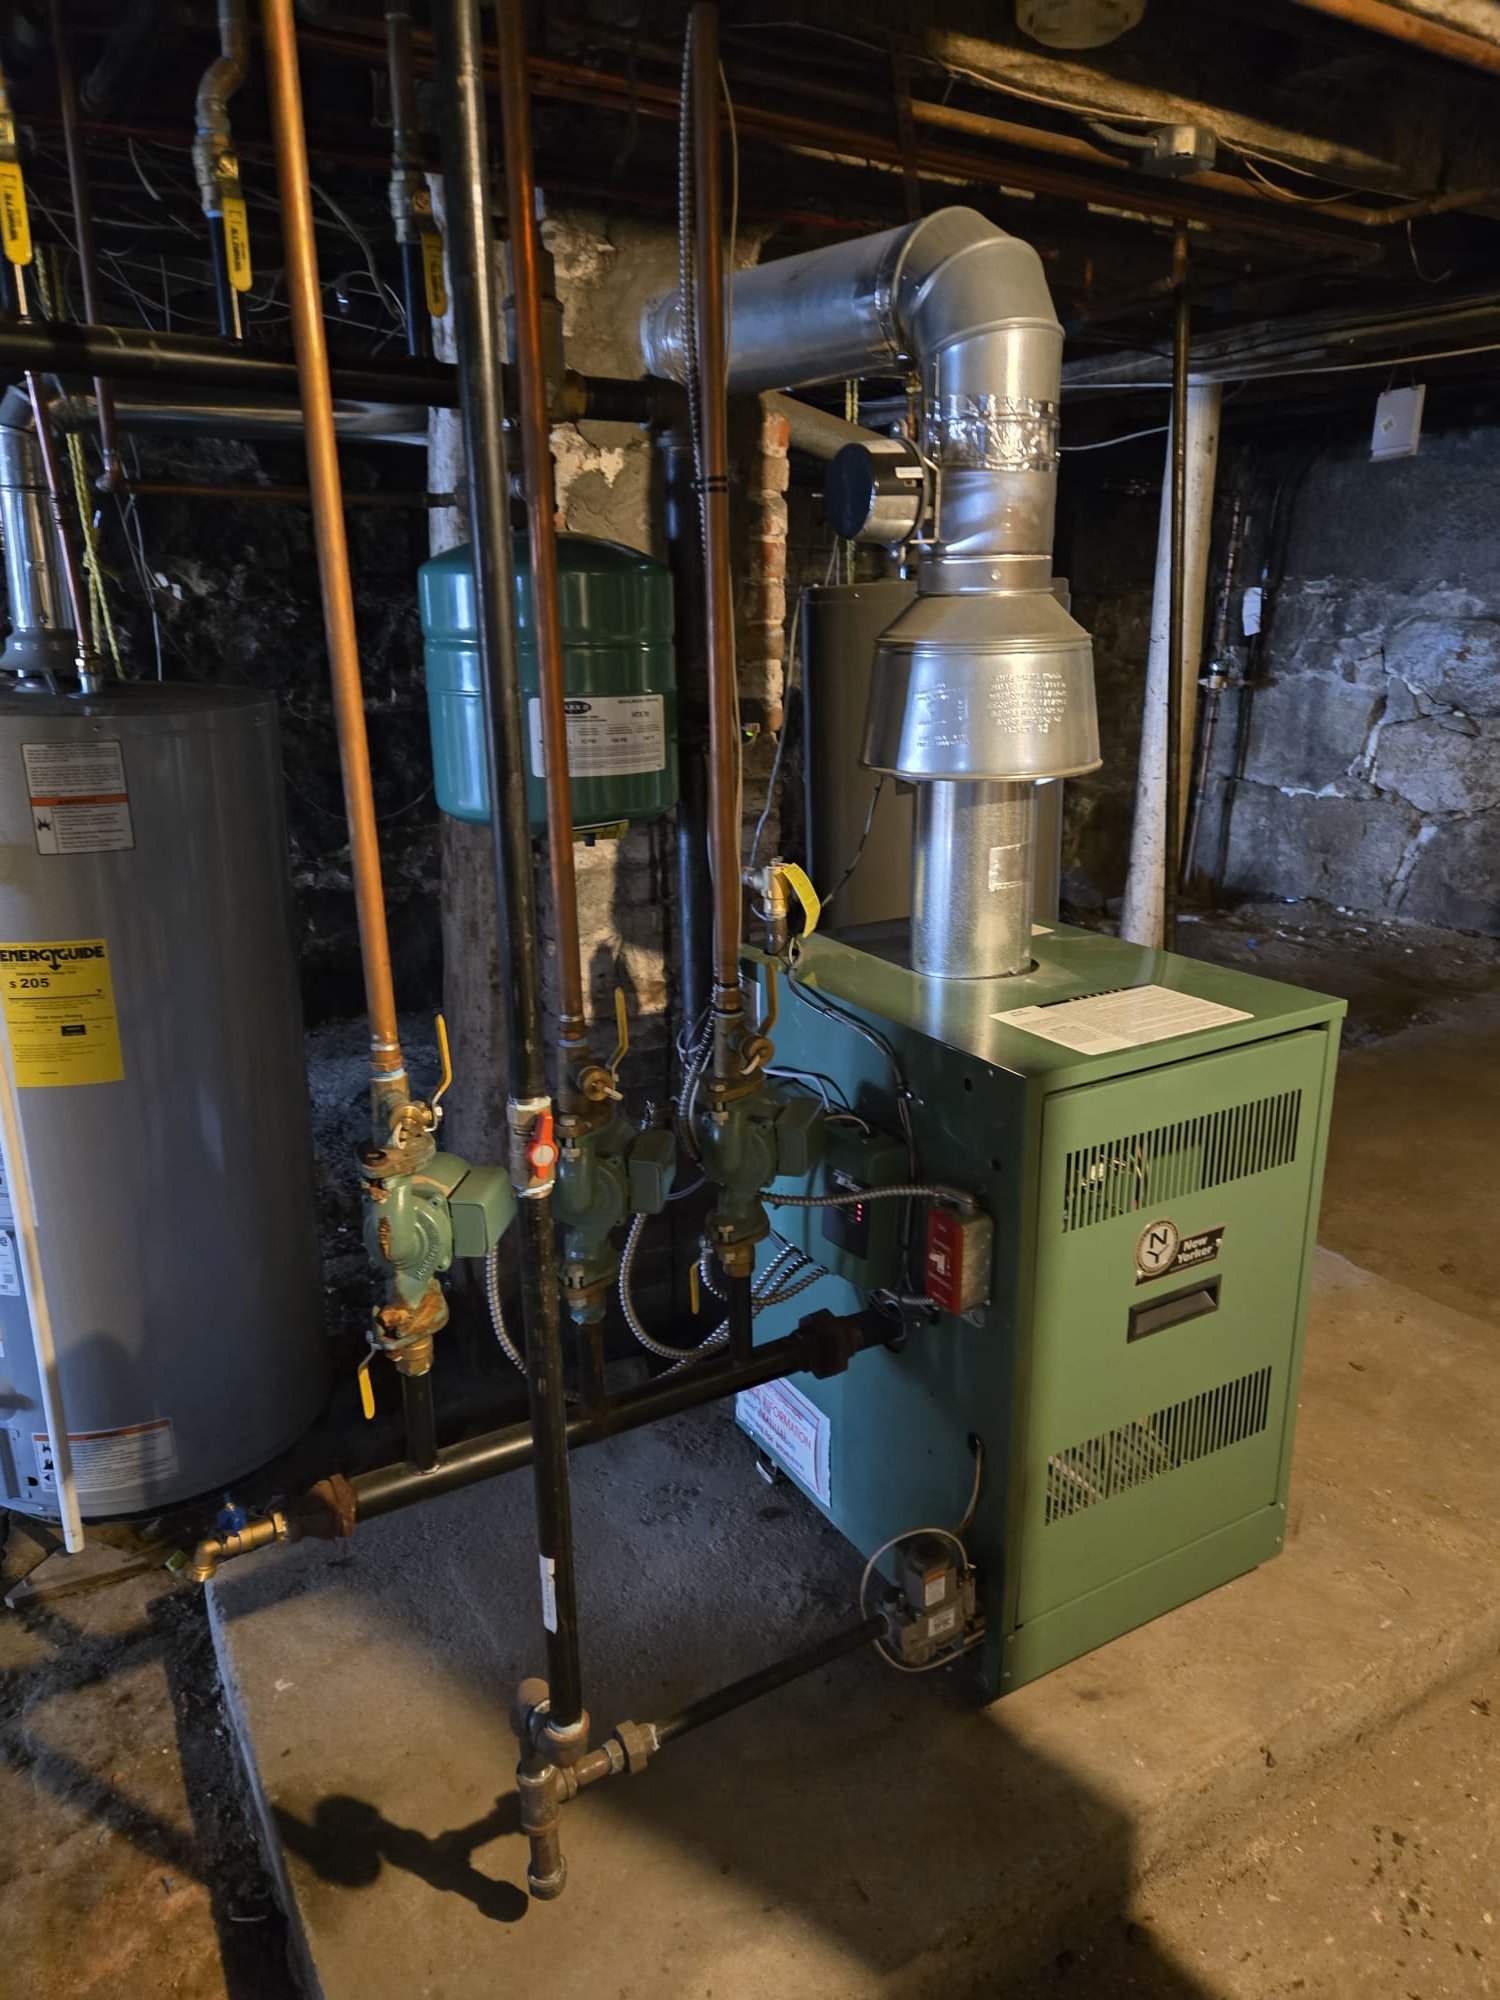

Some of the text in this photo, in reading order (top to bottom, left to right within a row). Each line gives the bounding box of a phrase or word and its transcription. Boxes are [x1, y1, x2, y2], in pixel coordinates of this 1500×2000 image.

[0, 946, 105, 967] ENERGYGUIDE
[20, 977, 50, 989] 205
[1183, 1236, 1209, 1251] New
[1177, 1246, 1214, 1264] Yorker
